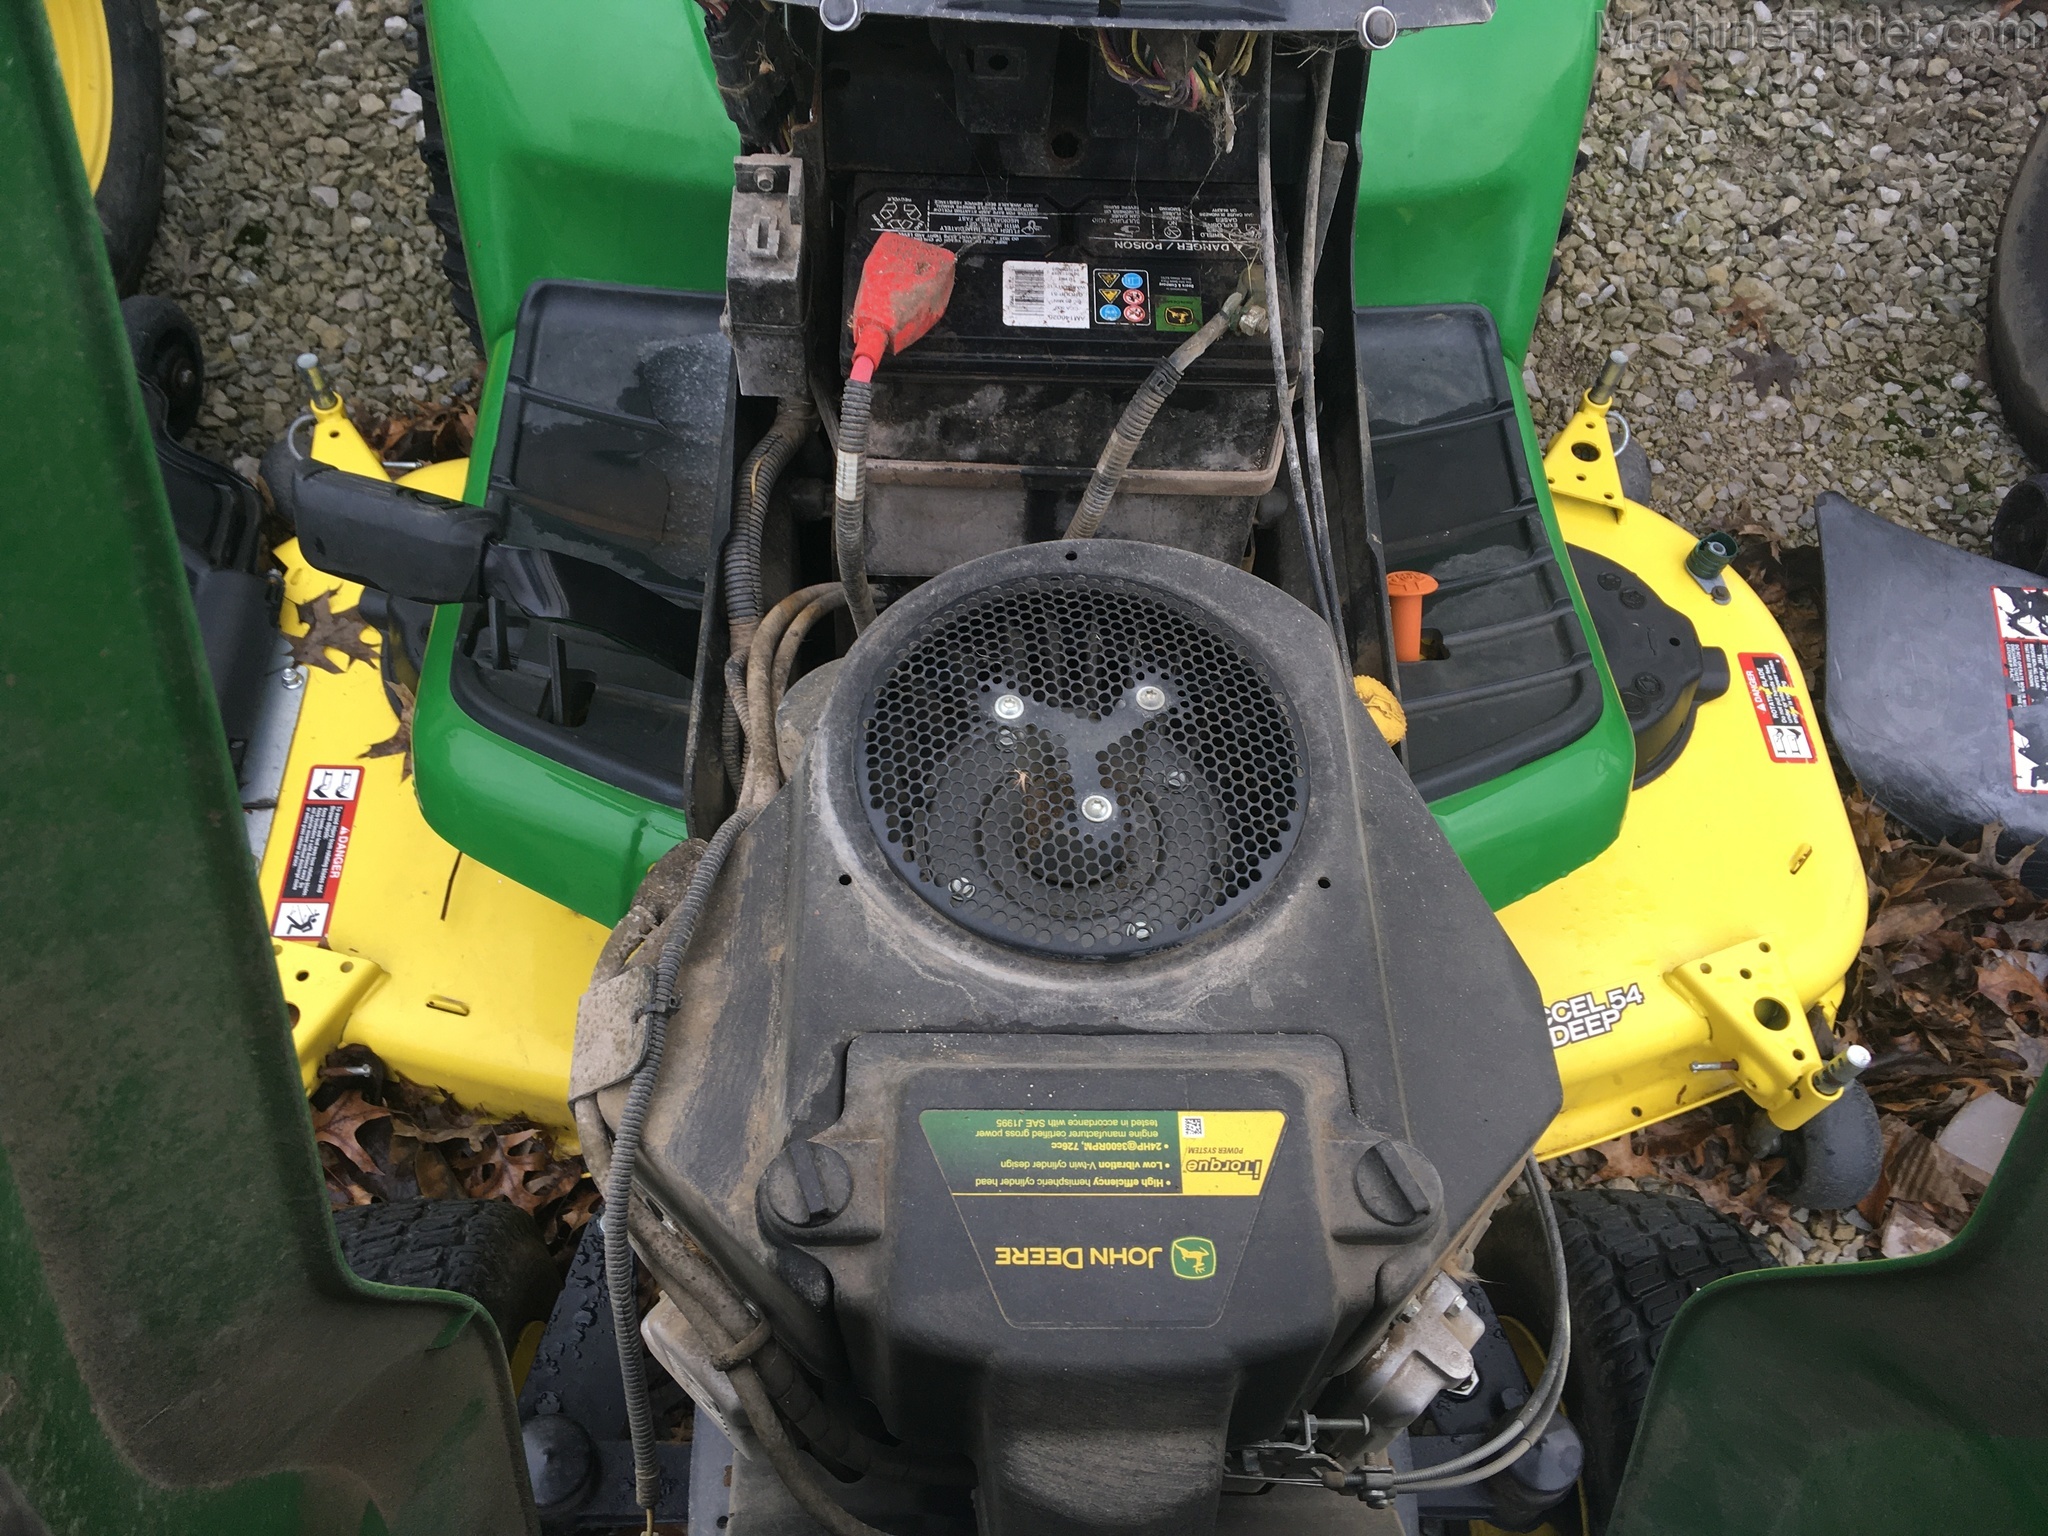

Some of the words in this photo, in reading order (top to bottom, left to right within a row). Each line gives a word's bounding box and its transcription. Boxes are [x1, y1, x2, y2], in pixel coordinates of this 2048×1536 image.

[1114, 241, 1163, 250] POISON
[1177, 242, 1230, 252] DANGER
[1756, 667, 1768, 687] BLADE
[1745, 670, 1762, 702] DANGER
[328, 835, 349, 878] DANGER
[1608, 983, 1644, 1011] 54
[1548, 1010, 1621, 1049] DEEP
[996, 1119, 1024, 1128] J1995
[1025, 1119, 1046, 1128] SAE
[1047, 1119, 1067, 1128] with
[1067, 1119, 1119, 1128] accordance
[1120, 1119, 1129, 1128] in
[1130, 1119, 1158, 1128] tested
[975, 1128, 1003, 1136] power
[1004, 1128, 1030, 1137] gross
[1032, 1130, 1067, 1139] certified
[1068, 1130, 1127, 1139] manufacturer
[1128, 1129, 1159, 1138] engine
[1051, 1141, 1080, 1150] 726cc
[1000, 1159, 1031, 1169] design
[1033, 1159, 1067, 1169] cylinder
[1069, 1161, 1097, 1170] V-twin
[1098, 1161, 1141, 1170] vibration
[1141, 1161, 1163, 1170] Low
[1185, 1157, 1263, 1181] iTorque
[975, 1178, 999, 1187] head
[1000, 1177, 1036, 1187] cylinder
[1037, 1177, 1091, 1187] hemispheric
[1092, 1177, 1140, 1188] efficiency
[1141, 1176, 1164, 1188] High
[995, 1247, 1084, 1269] DEERE
[1089, 1247, 1164, 1269] JOHN
